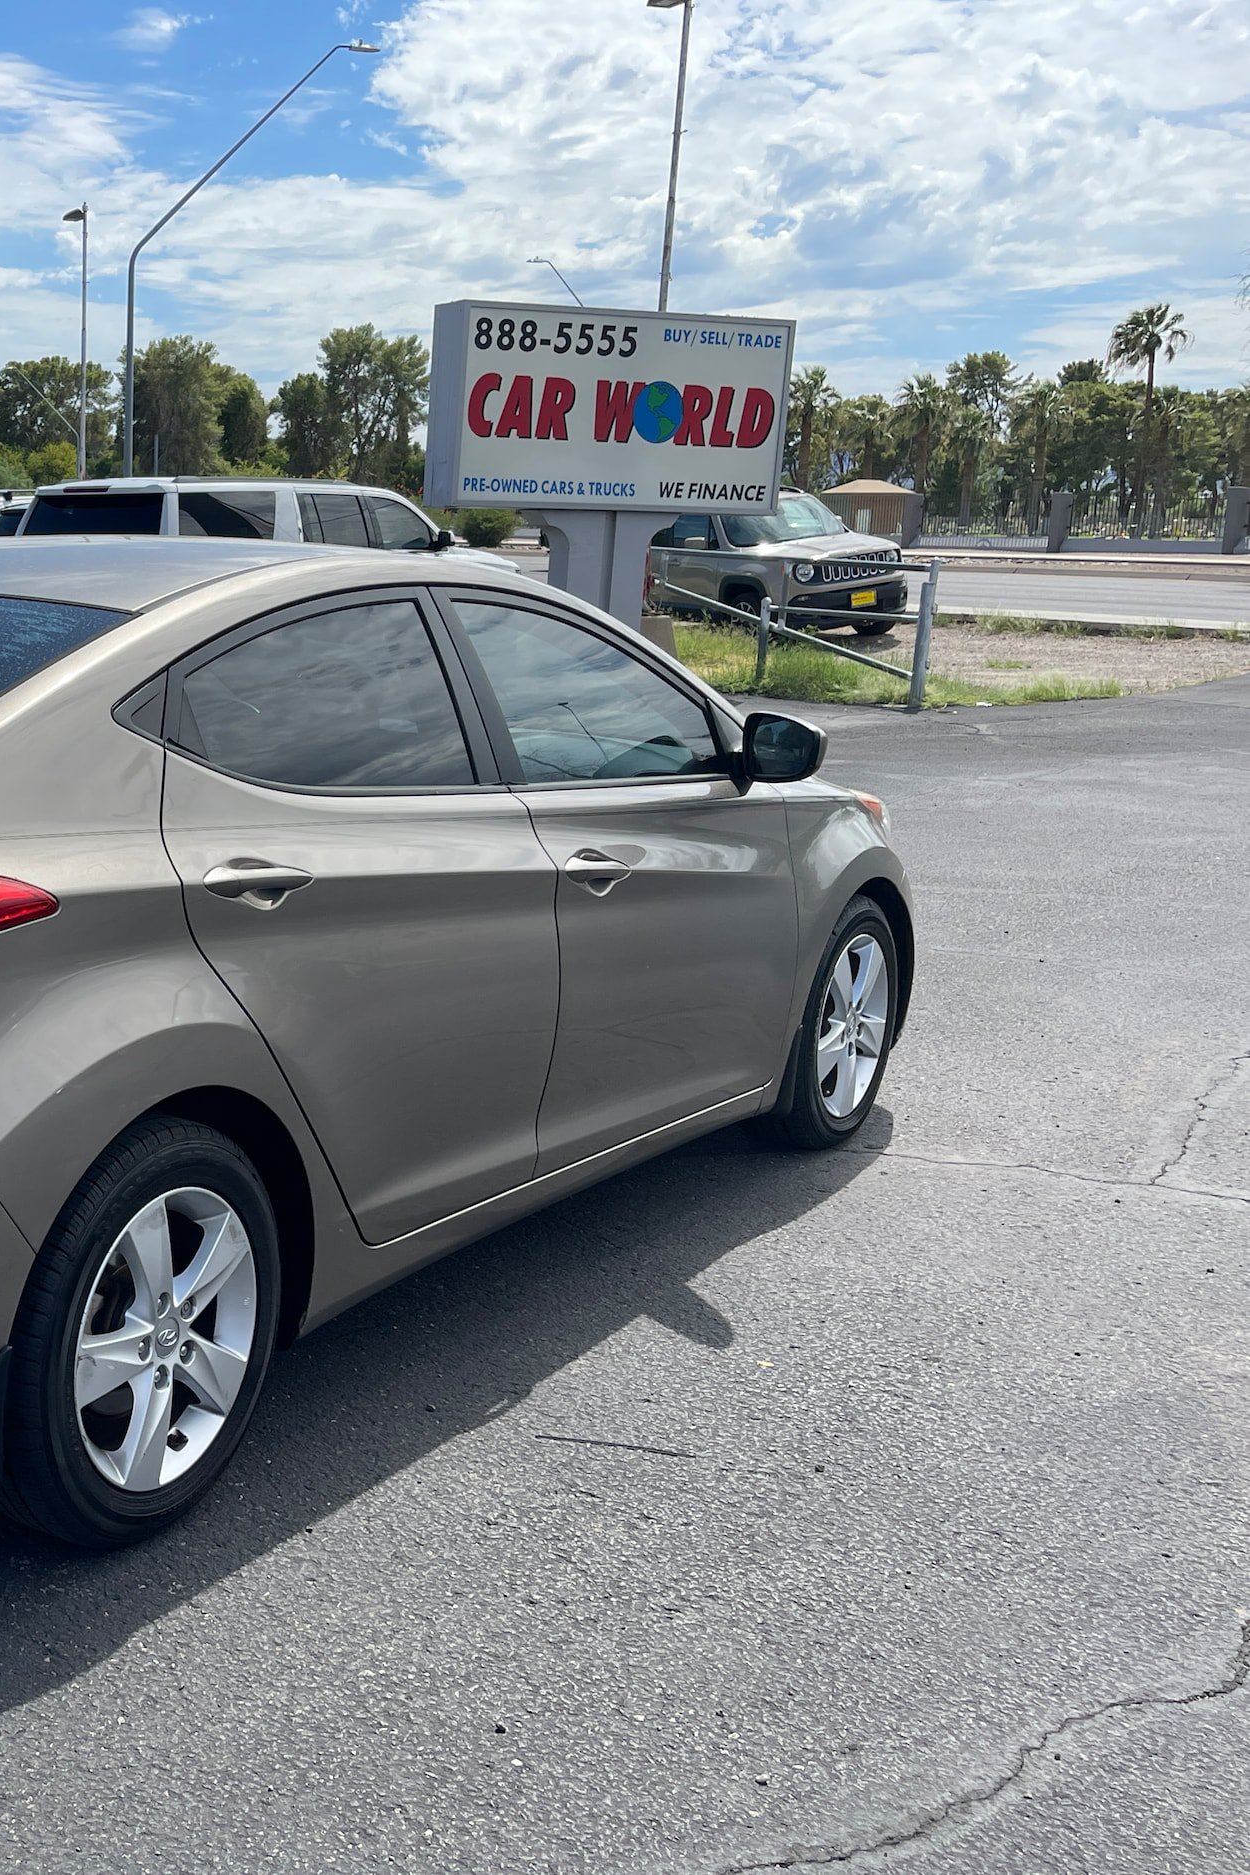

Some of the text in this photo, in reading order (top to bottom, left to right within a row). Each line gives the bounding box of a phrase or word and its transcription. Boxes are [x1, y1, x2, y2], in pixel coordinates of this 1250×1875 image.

[474, 316, 638, 357] 888-5555
[738, 333, 782, 349] TRADE
[467, 372, 576, 441] CAR
[463, 477, 636, 497] PRE-OWNED CARS & TRUCKS
[659, 481, 766, 502] WE FINANCE
